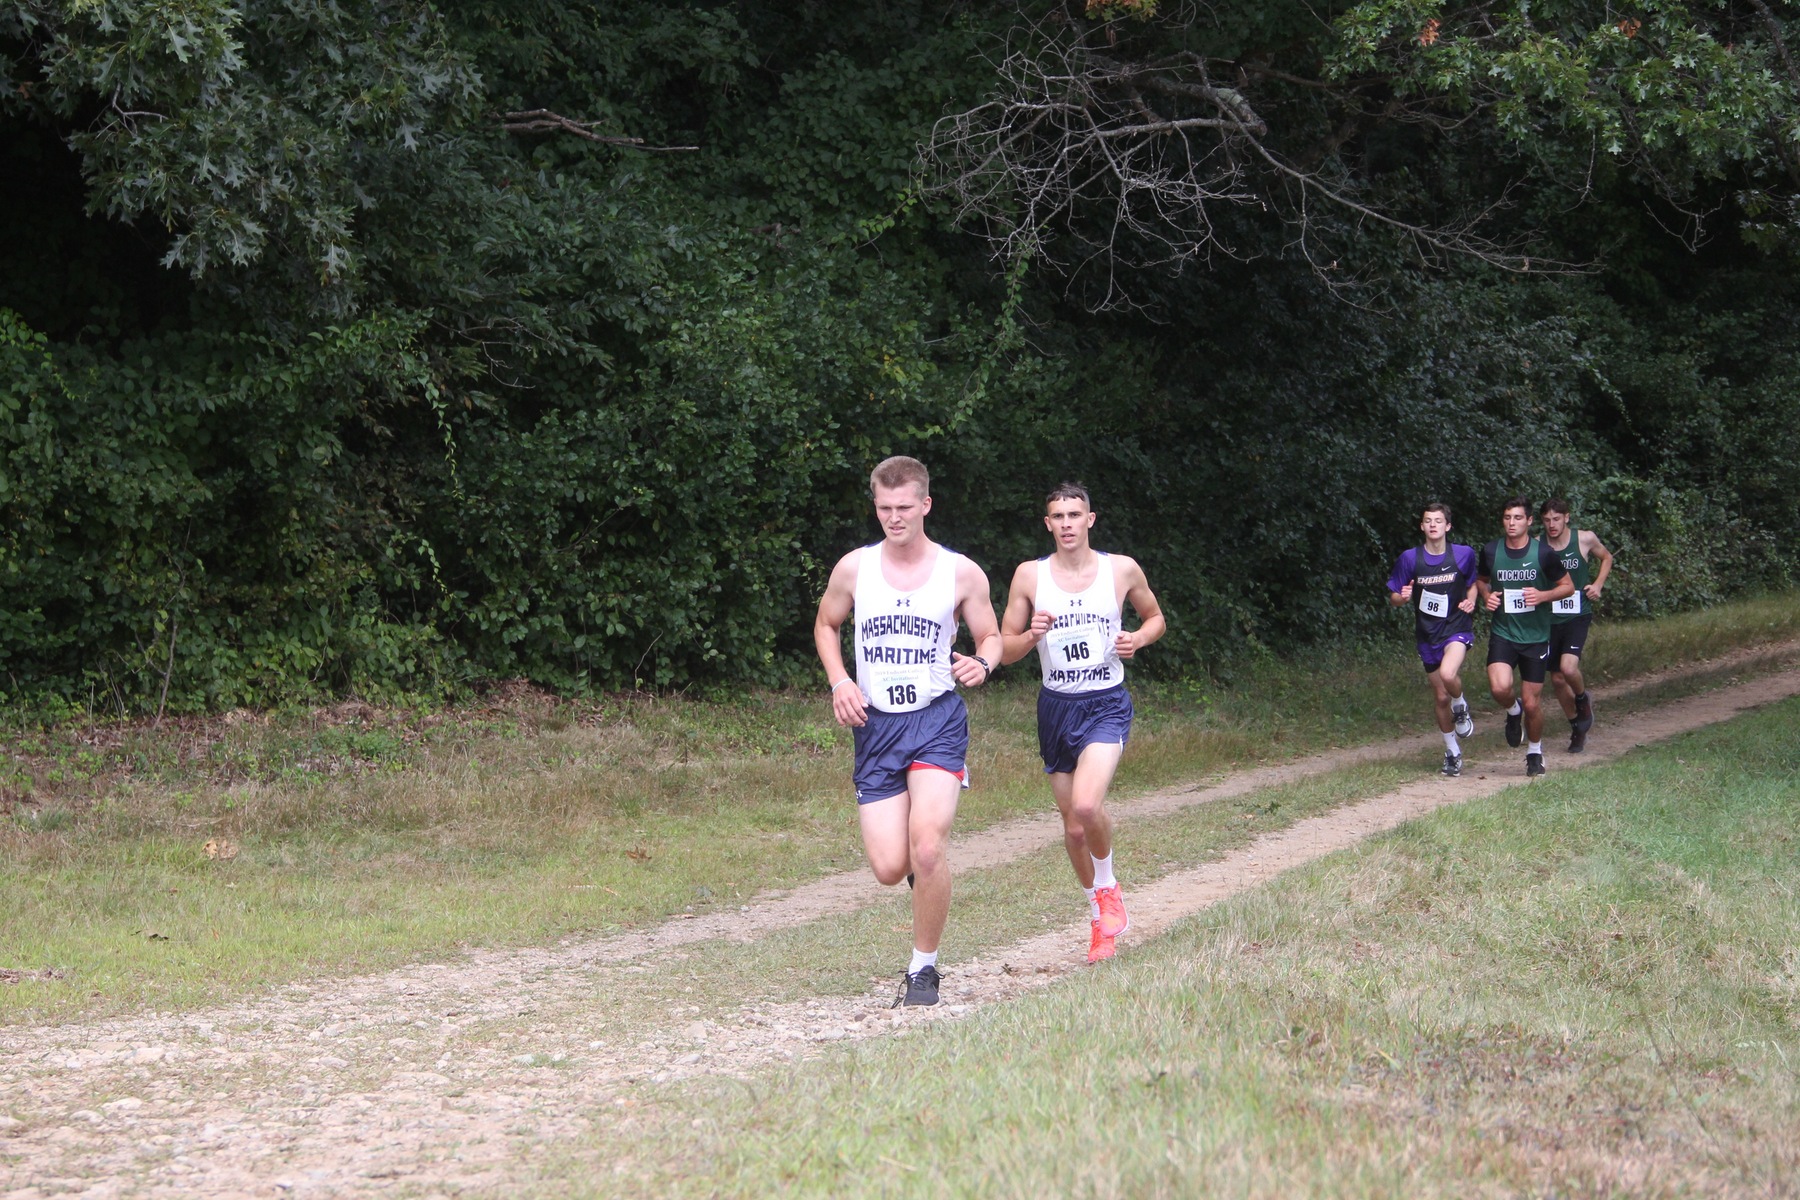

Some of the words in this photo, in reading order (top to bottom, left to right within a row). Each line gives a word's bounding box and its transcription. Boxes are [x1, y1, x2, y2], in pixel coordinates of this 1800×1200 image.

[1417, 573, 1456, 585] EMERSON
[1497, 569, 1537, 581] NICHOLS
[1427, 601, 1439, 612] 98
[1559, 599, 1574, 609] 160
[861, 614, 941, 643] MASSACHUSETTS
[863, 646, 936, 664] MARITIME
[1062, 641, 1090, 662] 146
[1049, 666, 1110, 683] MARITIME
[886, 684, 917, 705] 136
